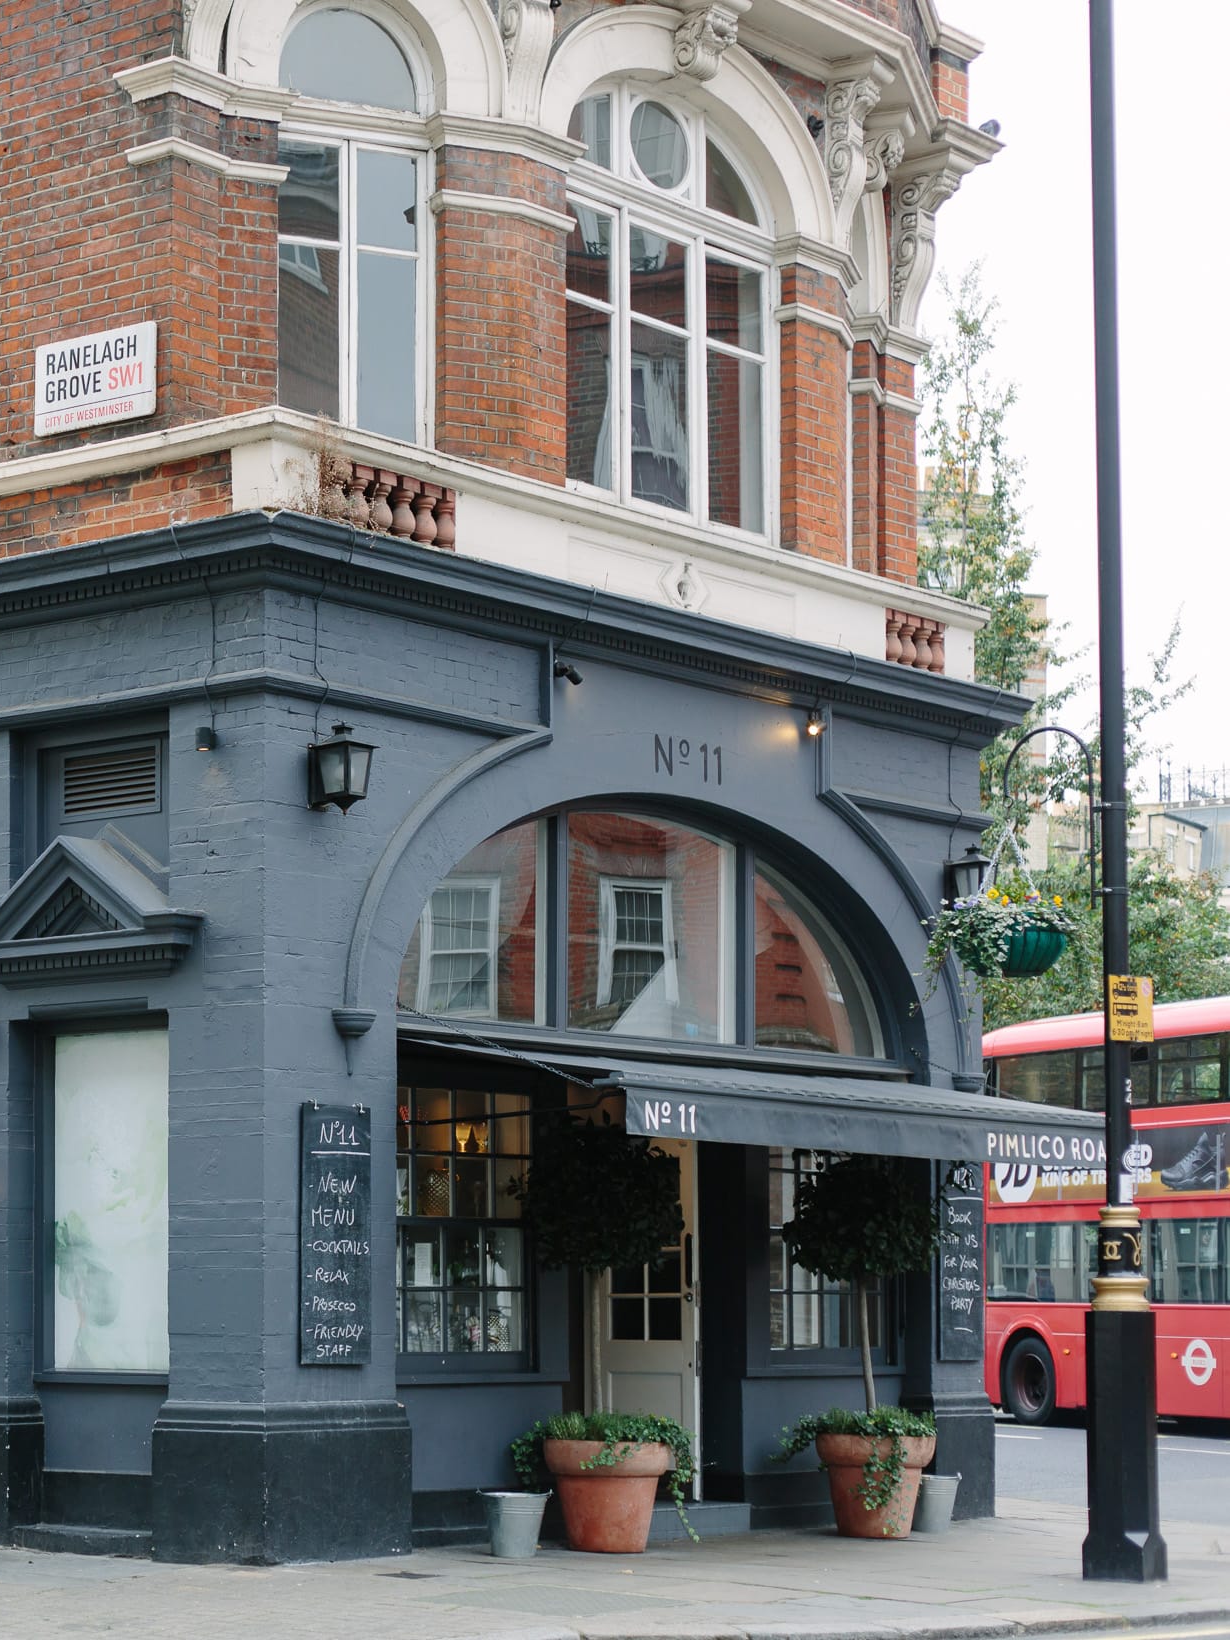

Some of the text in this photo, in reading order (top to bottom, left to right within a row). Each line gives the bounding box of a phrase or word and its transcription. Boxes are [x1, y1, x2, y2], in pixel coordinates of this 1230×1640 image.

[46, 335, 137, 375] RANELAGH
[45, 361, 143, 403] GROVE SW1
[45, 400, 133, 428] CITY OF WESTMINSTER
[700, 743, 721, 786] 11
[678, 1103, 696, 1134] 11
[987, 1132, 1065, 1160] PIMLICO
[1071, 1138, 1107, 1162] ROA
[1042, 1172, 1069, 1187] KING
[1072, 1172, 1088, 1186] OF
[311, 1205, 355, 1227] MENU
[964, 1234, 978, 1248] US
[959, 1254, 978, 1272] YOUR
[951, 1296, 974, 1315] PARTY
[316, 1344, 352, 1357] STAFF
